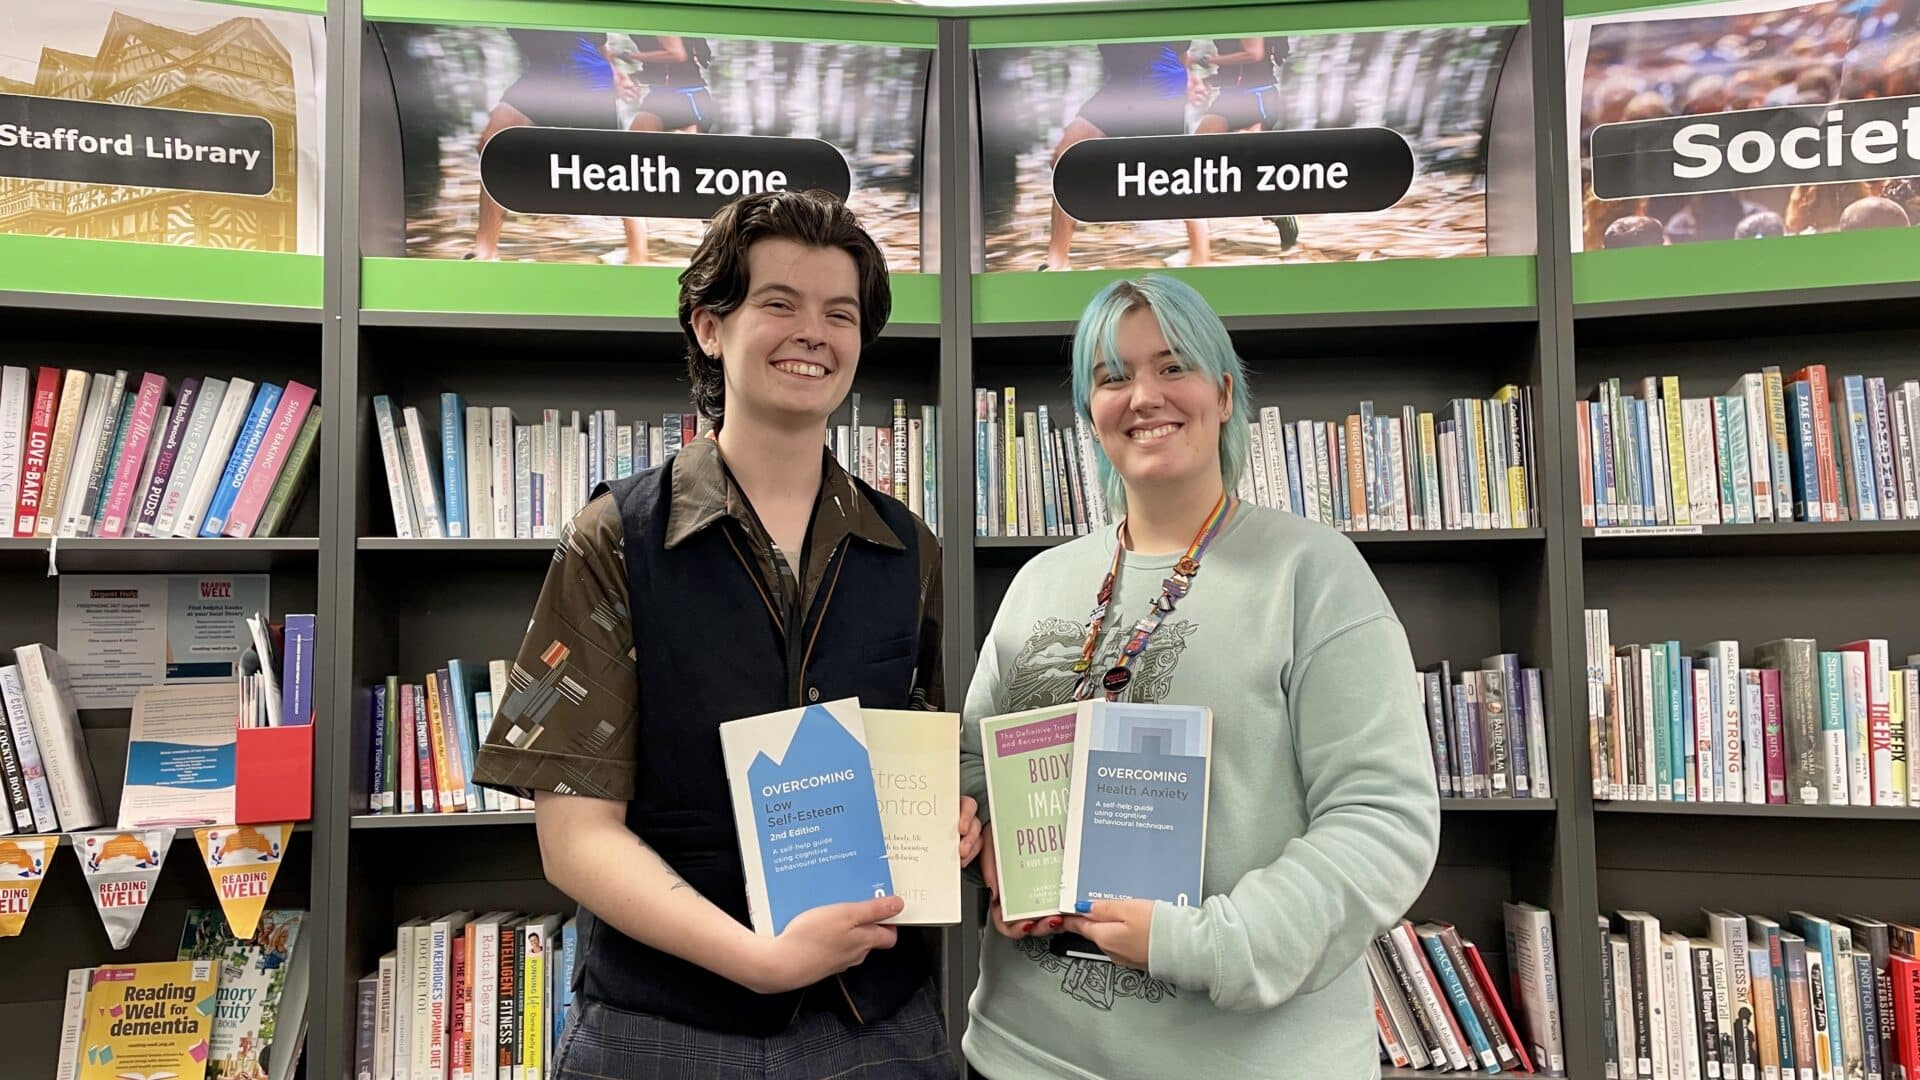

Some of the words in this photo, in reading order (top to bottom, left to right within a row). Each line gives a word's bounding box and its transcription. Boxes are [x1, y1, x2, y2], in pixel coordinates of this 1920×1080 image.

[0, 123, 134, 156] Stafford
[146, 136, 261, 171] Library
[550, 153, 680, 193] Health
[695, 166, 788, 195] zone
[1117, 156, 1242, 197] Health
[1256, 161, 1350, 192] zone
[138, 381, 161, 418] Rachel
[181, 389, 192, 406] Paul
[1771, 376, 1783, 419] FIGHTING
[1800, 395, 1810, 418] TAKE
[106, 415, 114, 429] the
[194, 386, 217, 437] LORRAINE
[260, 408, 272, 428] PAUL
[277, 399, 299, 435] SIMPLY
[1896, 400, 1906, 435] Remember
[128, 418, 151, 449] Allen
[166, 404, 187, 450] Hollywood's
[446, 409, 457, 461] Solitude
[894, 418, 906, 448] NEVER
[1352, 422, 1360, 456] TRIGGER
[1775, 422, 1785, 436] FIT
[1803, 421, 1812, 447] CARE
[30, 428, 45, 470] LOVE
[53, 446, 64, 475] NADIYA
[94, 429, 110, 470] handmade
[232, 427, 263, 488] HOLLYWOOD
[262, 437, 282, 470] BAKING
[895, 451, 907, 470] GIVE
[1512, 442, 1521, 465] Colitis
[0, 429, 14, 495] BAKING
[156, 451, 172, 476] PIES
[175, 439, 200, 488] PASCALE
[1354, 458, 1362, 488] POINTS
[23, 468, 38, 510] BAKE
[46, 475, 59, 509] HUSSAIN
[88, 471, 98, 490] loaf
[154, 477, 165, 489] &
[144, 488, 162, 517] PUDS
[202, 588, 231, 598] WELL
[1726, 647, 1735, 680] ASHLEY
[1827, 657, 1839, 689] Stacey
[1728, 683, 1736, 705] CAIN
[1766, 693, 1781, 725] private
[1829, 693, 1840, 726] Dooley
[1871, 702, 1890, 727] THE
[10, 697, 32, 748] COCKTAILS
[1000, 731, 1014, 740] The
[1016, 726, 1051, 739] Definitive
[1494, 718, 1503, 751] PATIENT
[1890, 721, 1904, 743] THE
[1001, 740, 1016, 748] and
[1018, 735, 1052, 748] Recovery
[1726, 710, 1740, 774] STRONG
[1767, 732, 1781, 758] parts
[1872, 729, 1891, 752] FIX
[1890, 744, 1905, 762] FIX
[0, 730, 14, 778] COCKTAIL
[8, 774, 24, 804] BOOK
[873, 768, 928, 790] tress
[1028, 754, 1070, 784] BODY
[1098, 766, 1188, 784] OVERCOMING
[762, 769, 855, 798] OVERCOMING
[1096, 783, 1137, 797] Health
[1140, 785, 1189, 800] Anxiety
[765, 800, 792, 814] Low
[768, 804, 845, 828] Self-Esteem
[1094, 810, 1113, 818] using
[1115, 810, 1146, 821] cognitive
[1102, 800, 1132, 812] self-help
[1133, 804, 1154, 812] guide
[769, 832, 787, 842] 2nd
[789, 824, 820, 838] Edition
[1094, 818, 1134, 828] behavioural
[1135, 821, 1174, 831] techniques
[780, 842, 811, 854] self-help
[812, 838, 833, 848] guide
[1016, 824, 1065, 856] PROBL
[774, 855, 793, 865] using
[795, 848, 828, 860] cognitive
[775, 858, 817, 872] behavioural
[818, 850, 857, 864] techniques
[100, 880, 147, 893] READING
[222, 872, 268, 884] READING
[222, 882, 267, 898] WELL
[100, 892, 146, 908] WELL
[1088, 891, 1102, 899] ROB
[1103, 892, 1133, 900] WILLSON
[434, 930, 444, 948] TOM
[1539, 925, 1551, 953] Catch
[1732, 926, 1742, 938] THE
[416, 938, 428, 988] DOCTOR
[457, 962, 465, 977] THE
[481, 935, 494, 981] Radical
[500, 930, 514, 996] INTELLIGENT
[1542, 952, 1552, 973] Your
[1699, 950, 1711, 975] Broken
[1732, 939, 1746, 985] LIGHTLESS
[432, 950, 444, 1000] KERRIDGE'S
[1390, 953, 1405, 972] Henry
[1400, 973, 1414, 993] Marsh
[1434, 945, 1454, 976] BACK
[1451, 982, 1468, 1006] LIFE
[1460, 964, 1476, 988] BARNES
[1701, 976, 1712, 990] and
[1714, 960, 1726, 990] Afraid
[1860, 968, 1872, 989] NOT
[1912, 970, 1920, 983] WE
[124, 984, 196, 1002] Reading
[216, 986, 258, 1006] mory
[1545, 972, 1555, 1004] Breath
[1717, 992, 1726, 1002] to
[1736, 986, 1748, 1004] SKY
[1862, 990, 1875, 1009] FOR
[125, 1002, 166, 1020] Well
[170, 1004, 188, 1015] for
[216, 1000, 251, 1025] ivity
[416, 994, 427, 1016] YOU
[456, 1003, 464, 1011] IT
[478, 984, 493, 1026] Beauty
[1702, 990, 1716, 1023] Betrayed
[1718, 1003, 1728, 1020] Tell
[1876, 967, 1891, 1040] AFTERSHOCK
[110, 1016, 198, 1036] dementia
[217, 1020, 238, 1028] BOOK
[430, 1002, 443, 1048] DOPAMINE
[455, 1013, 464, 1034] DIET
[500, 1000, 513, 1044] FITNESS
[1550, 1020, 1559, 1041] Patrick
[1864, 1011, 1877, 1032] YOU
[464, 1039, 472, 1050] TOM
[430, 1050, 442, 1070] DIET
